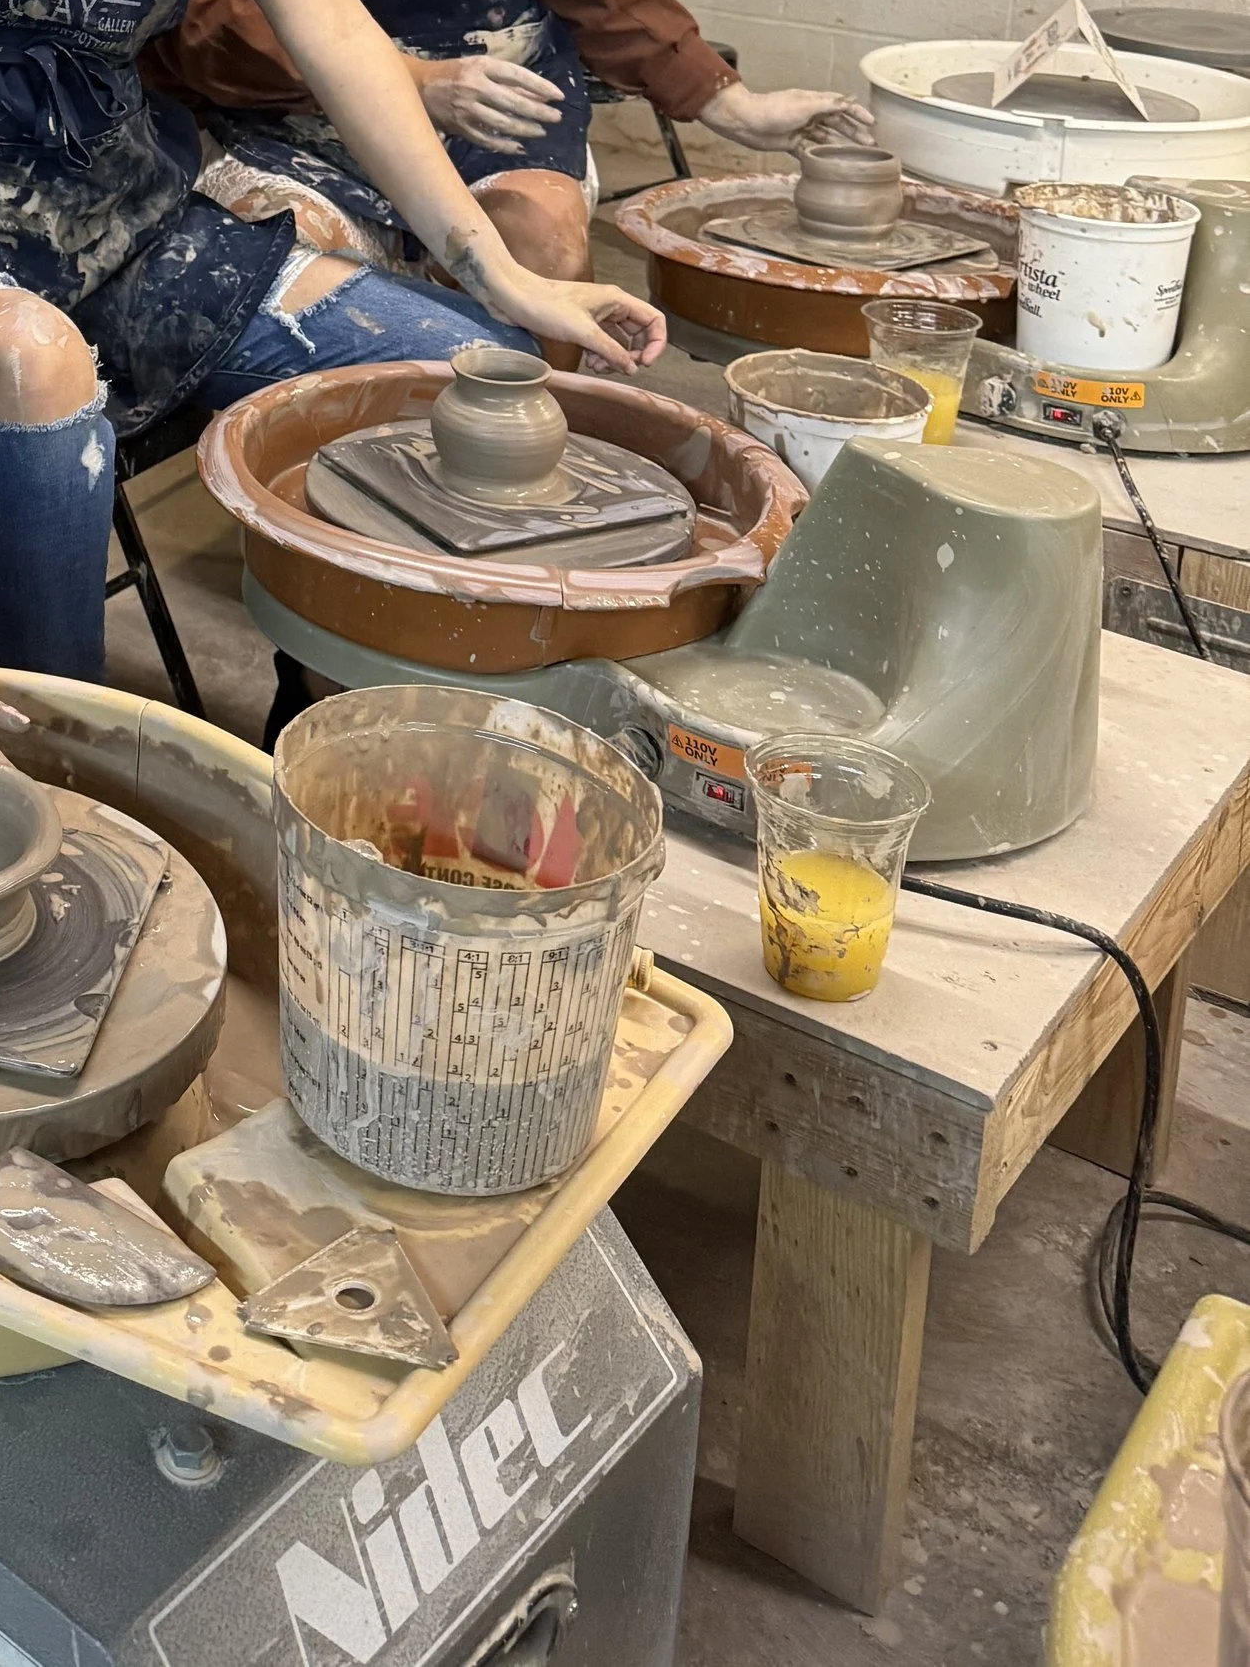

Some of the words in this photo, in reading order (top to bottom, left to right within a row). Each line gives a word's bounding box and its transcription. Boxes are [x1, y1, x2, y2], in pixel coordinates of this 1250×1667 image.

[1102, 387, 1129, 396] 10V
[1101, 395, 1130, 404] ONLY
[685, 736, 717, 756] 110V
[684, 746, 718, 767] ONLY
[464, 953, 480, 961] 4:1
[474, 971, 482, 979] 5
[458, 1003, 464, 1011] 5
[454, 1034, 462, 1042] 4
[275, 1340, 592, 1667] Nidec
